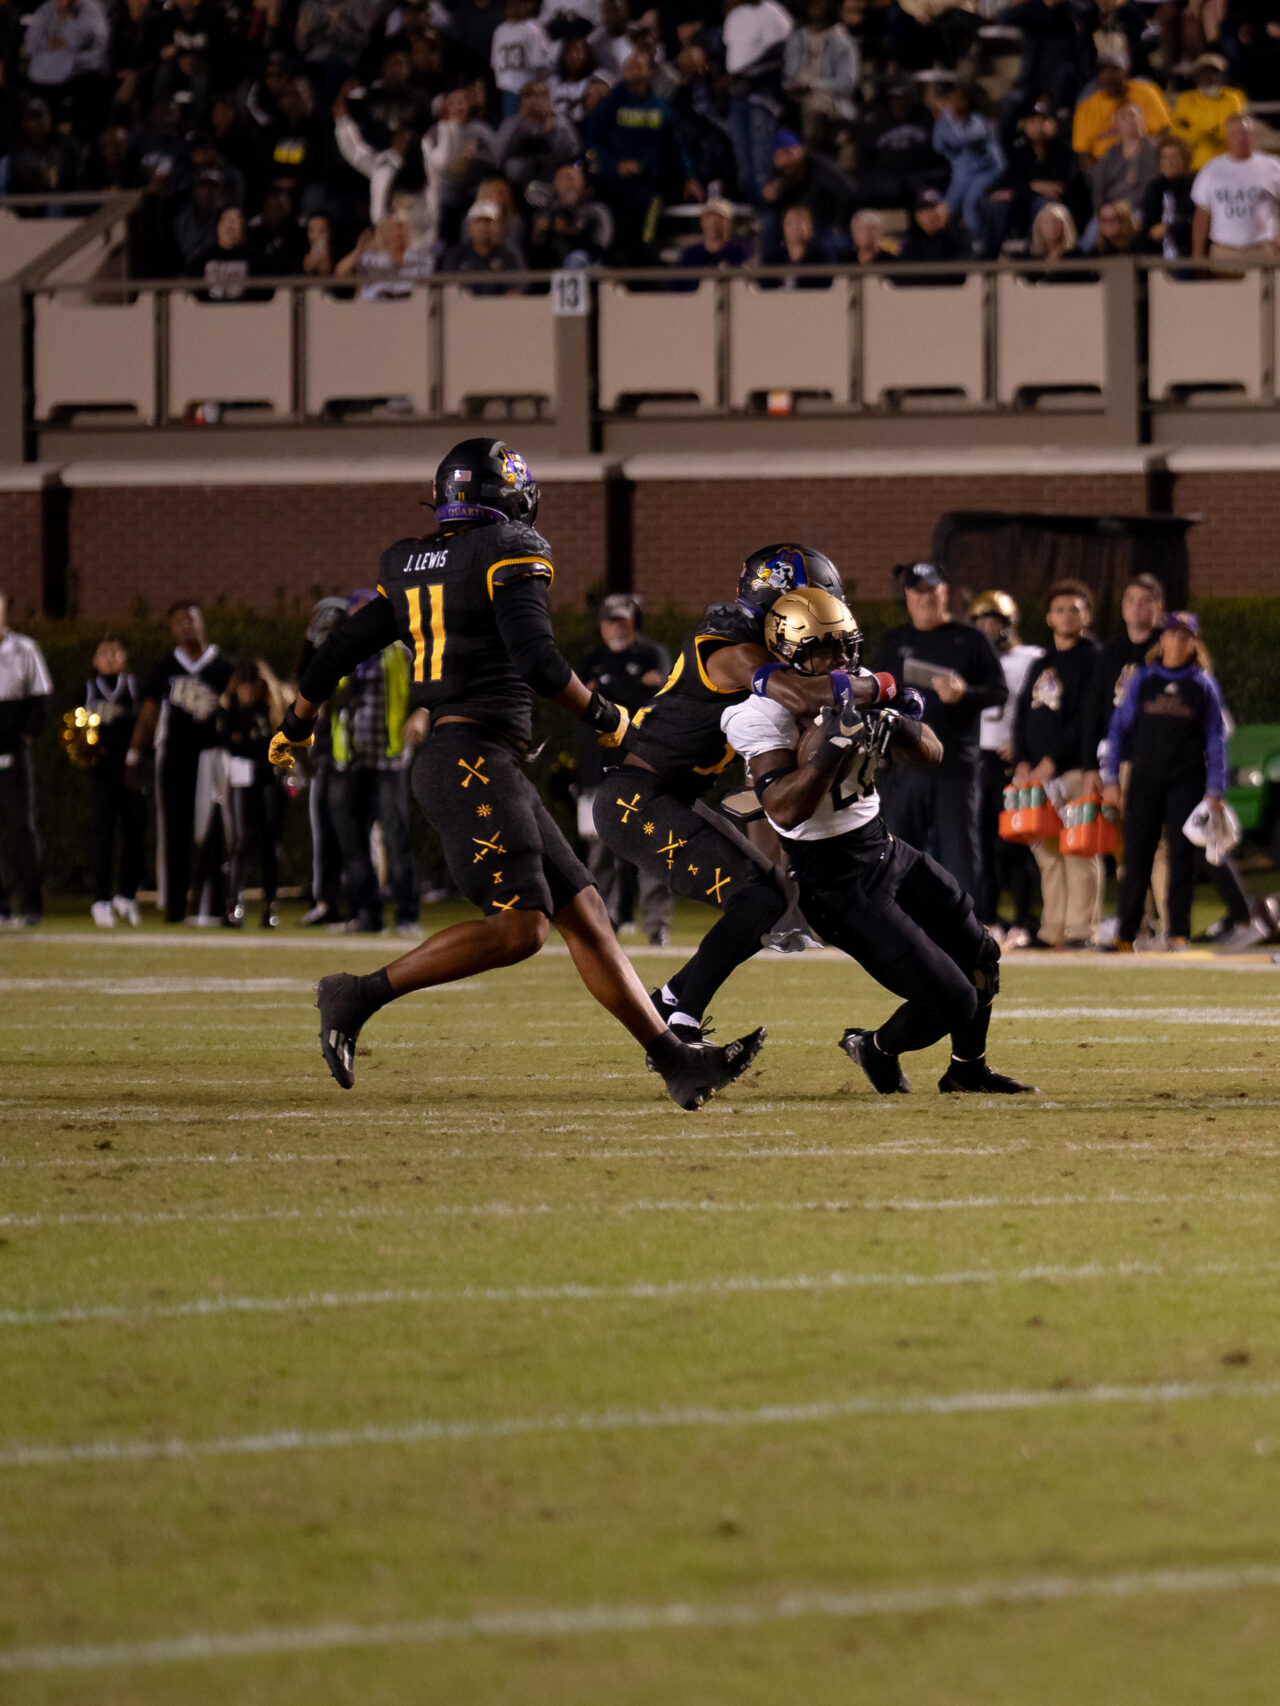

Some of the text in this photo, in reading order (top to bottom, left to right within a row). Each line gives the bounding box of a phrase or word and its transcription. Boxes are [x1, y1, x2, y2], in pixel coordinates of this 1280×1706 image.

[559, 278, 579, 307] 13
[414, 549, 449, 571] LEWIS
[404, 583, 447, 682] 11
